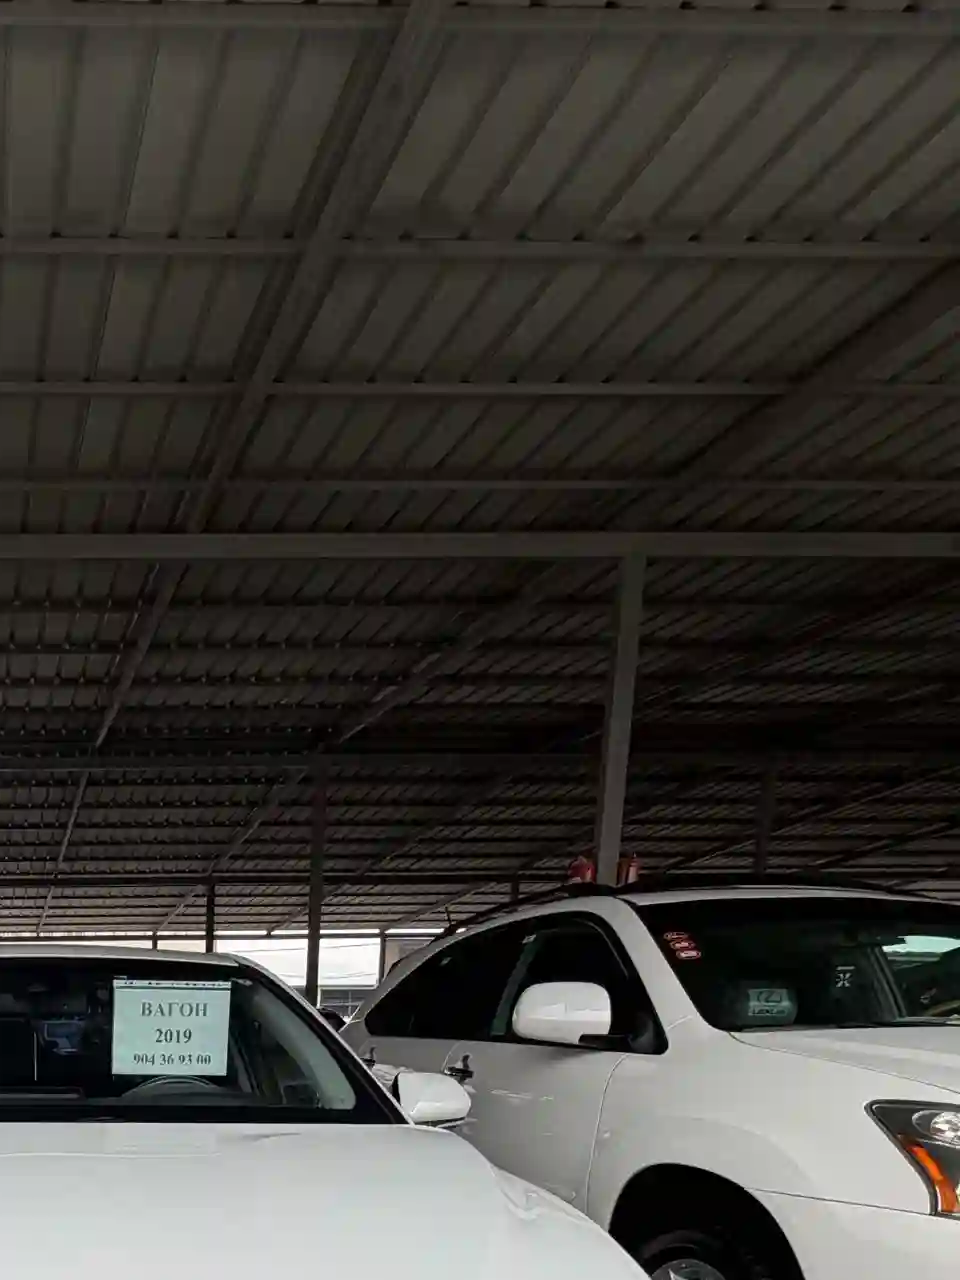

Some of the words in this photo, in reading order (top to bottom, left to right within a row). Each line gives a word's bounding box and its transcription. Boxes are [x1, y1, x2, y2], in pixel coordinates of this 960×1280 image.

[141, 1001, 208, 1017] ВАГОН
[155, 1028, 192, 1044] 2019
[133, 1053, 156, 1066] 904
[159, 1053, 174, 1066] 36
[196, 1054, 212, 1065] 00
